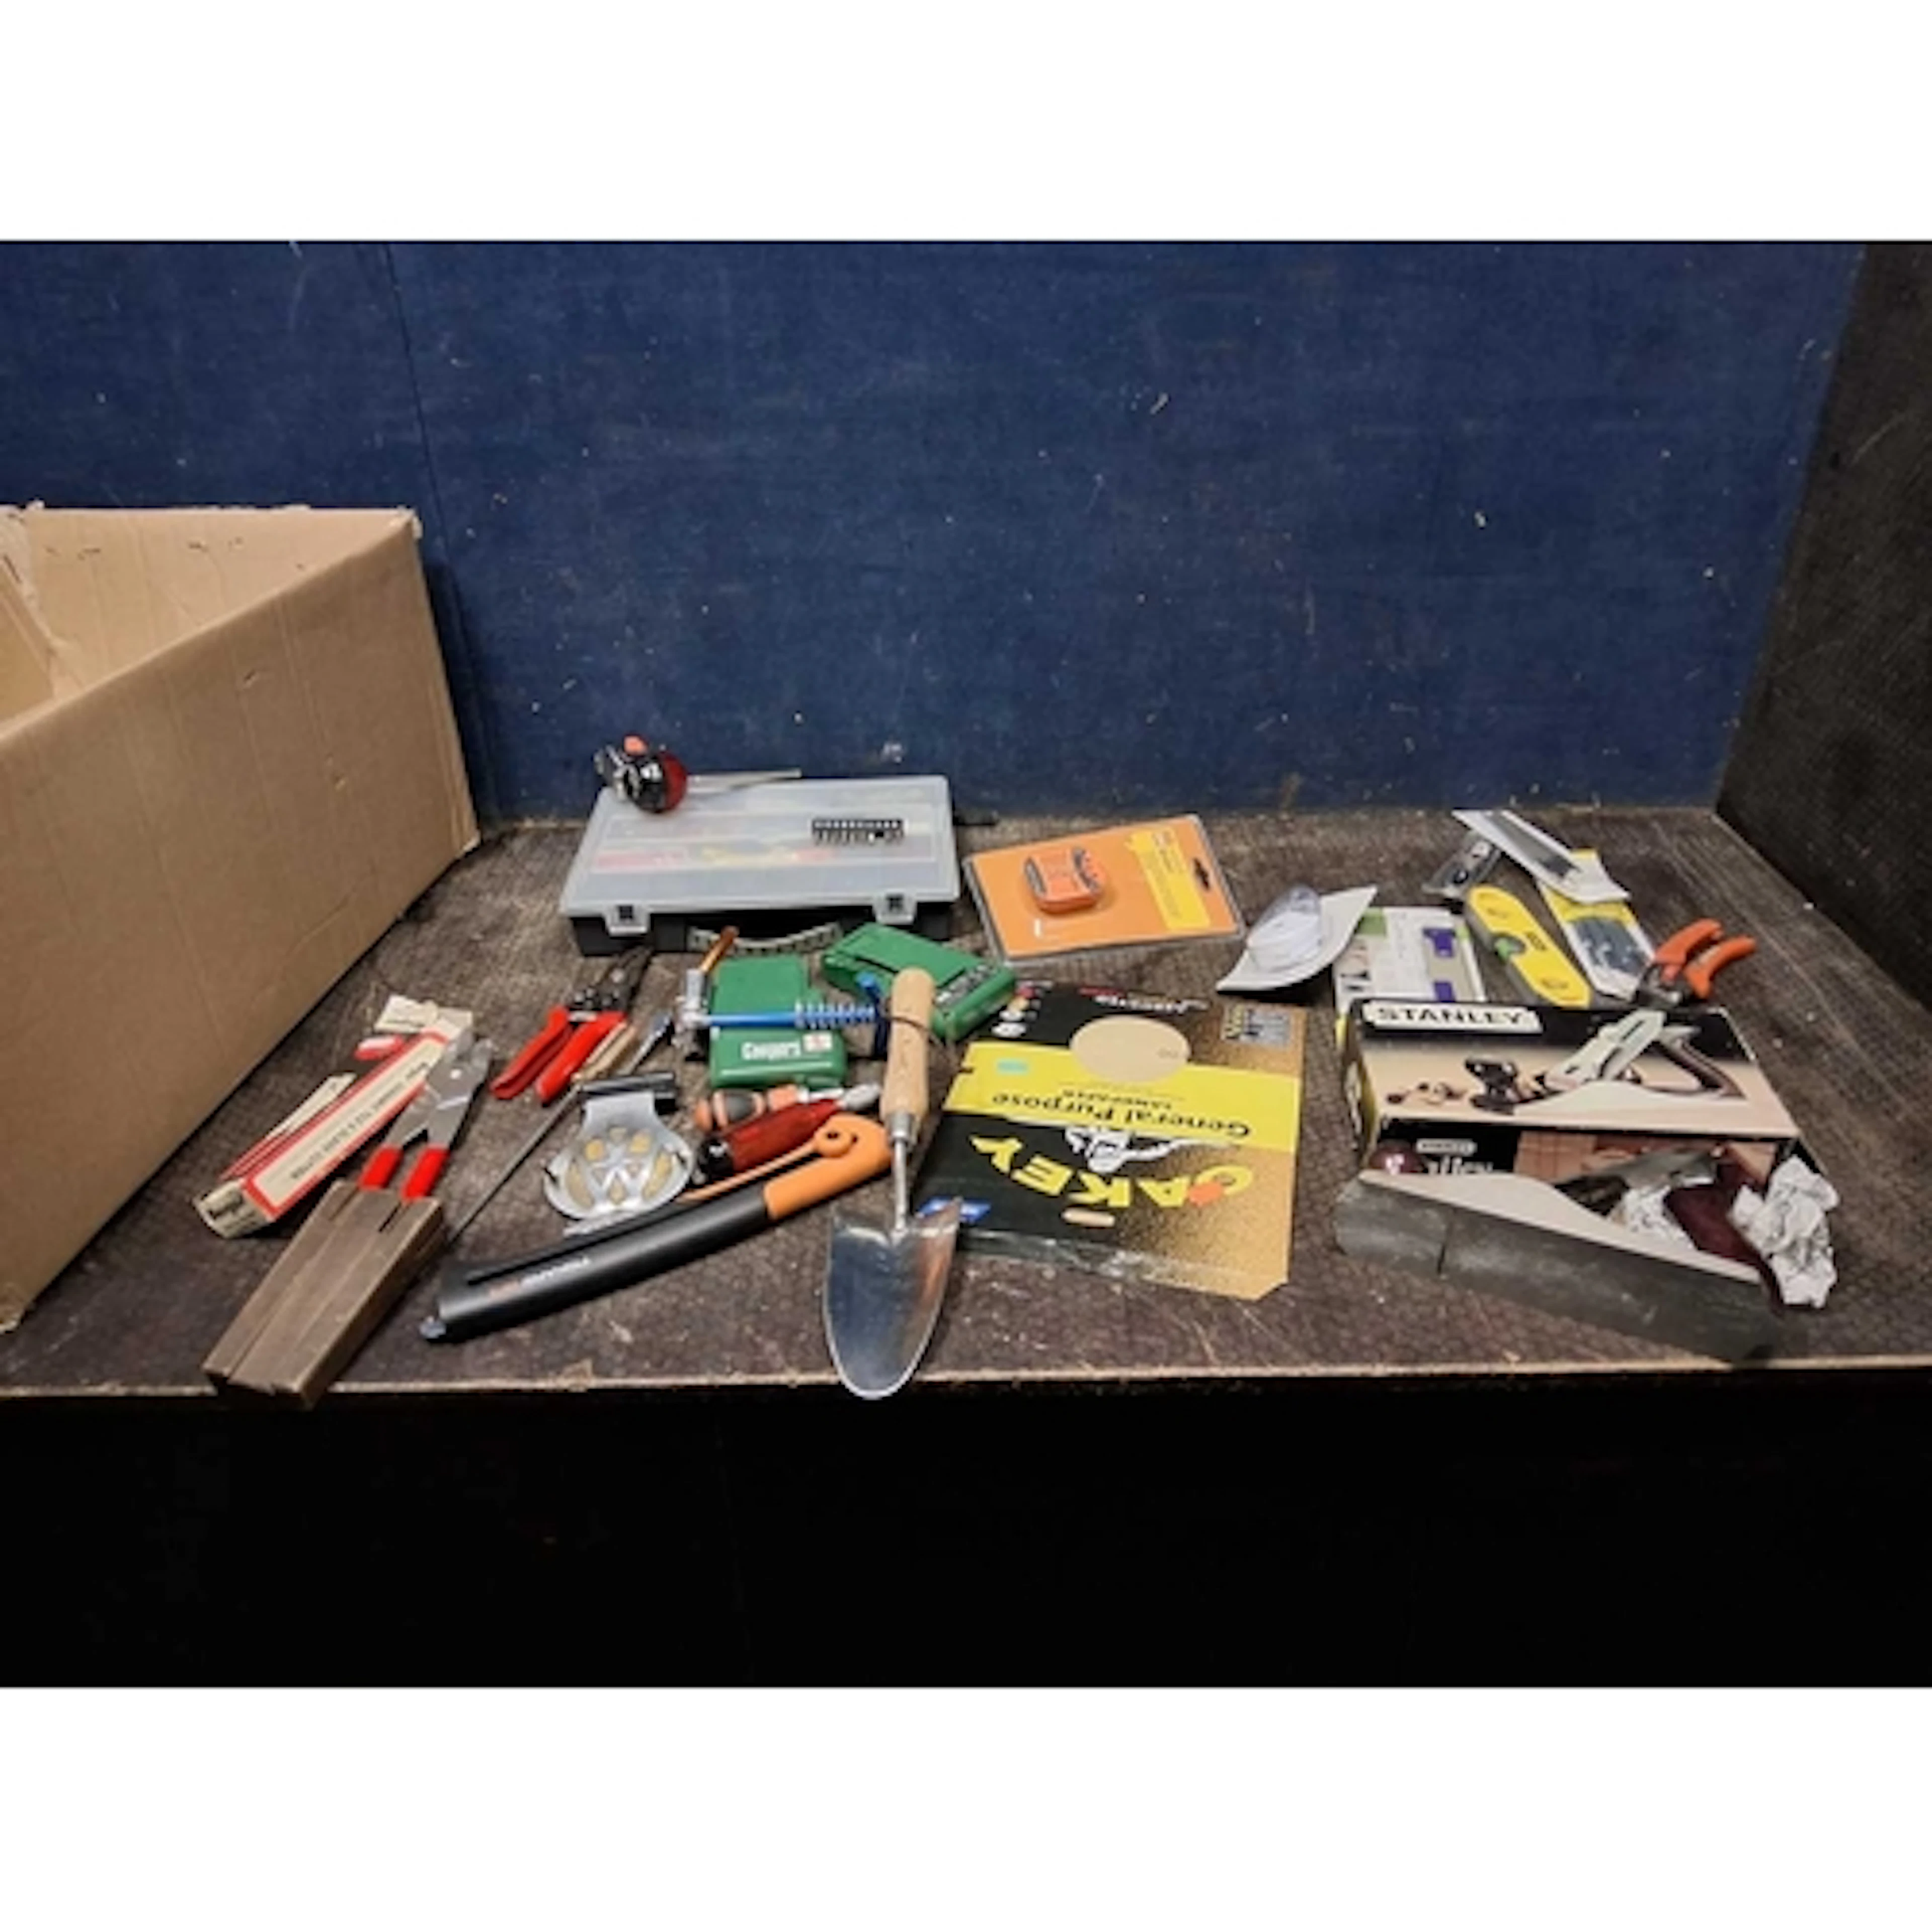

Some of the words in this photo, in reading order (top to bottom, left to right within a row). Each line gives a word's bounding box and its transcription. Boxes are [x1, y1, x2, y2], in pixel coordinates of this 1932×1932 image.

[1377, 1006, 1523, 1027] STANLEY
[992, 1093, 1114, 1122] Purpose
[1124, 1110, 1251, 1138] General
[968, 1136, 1254, 1208] OAKEY
